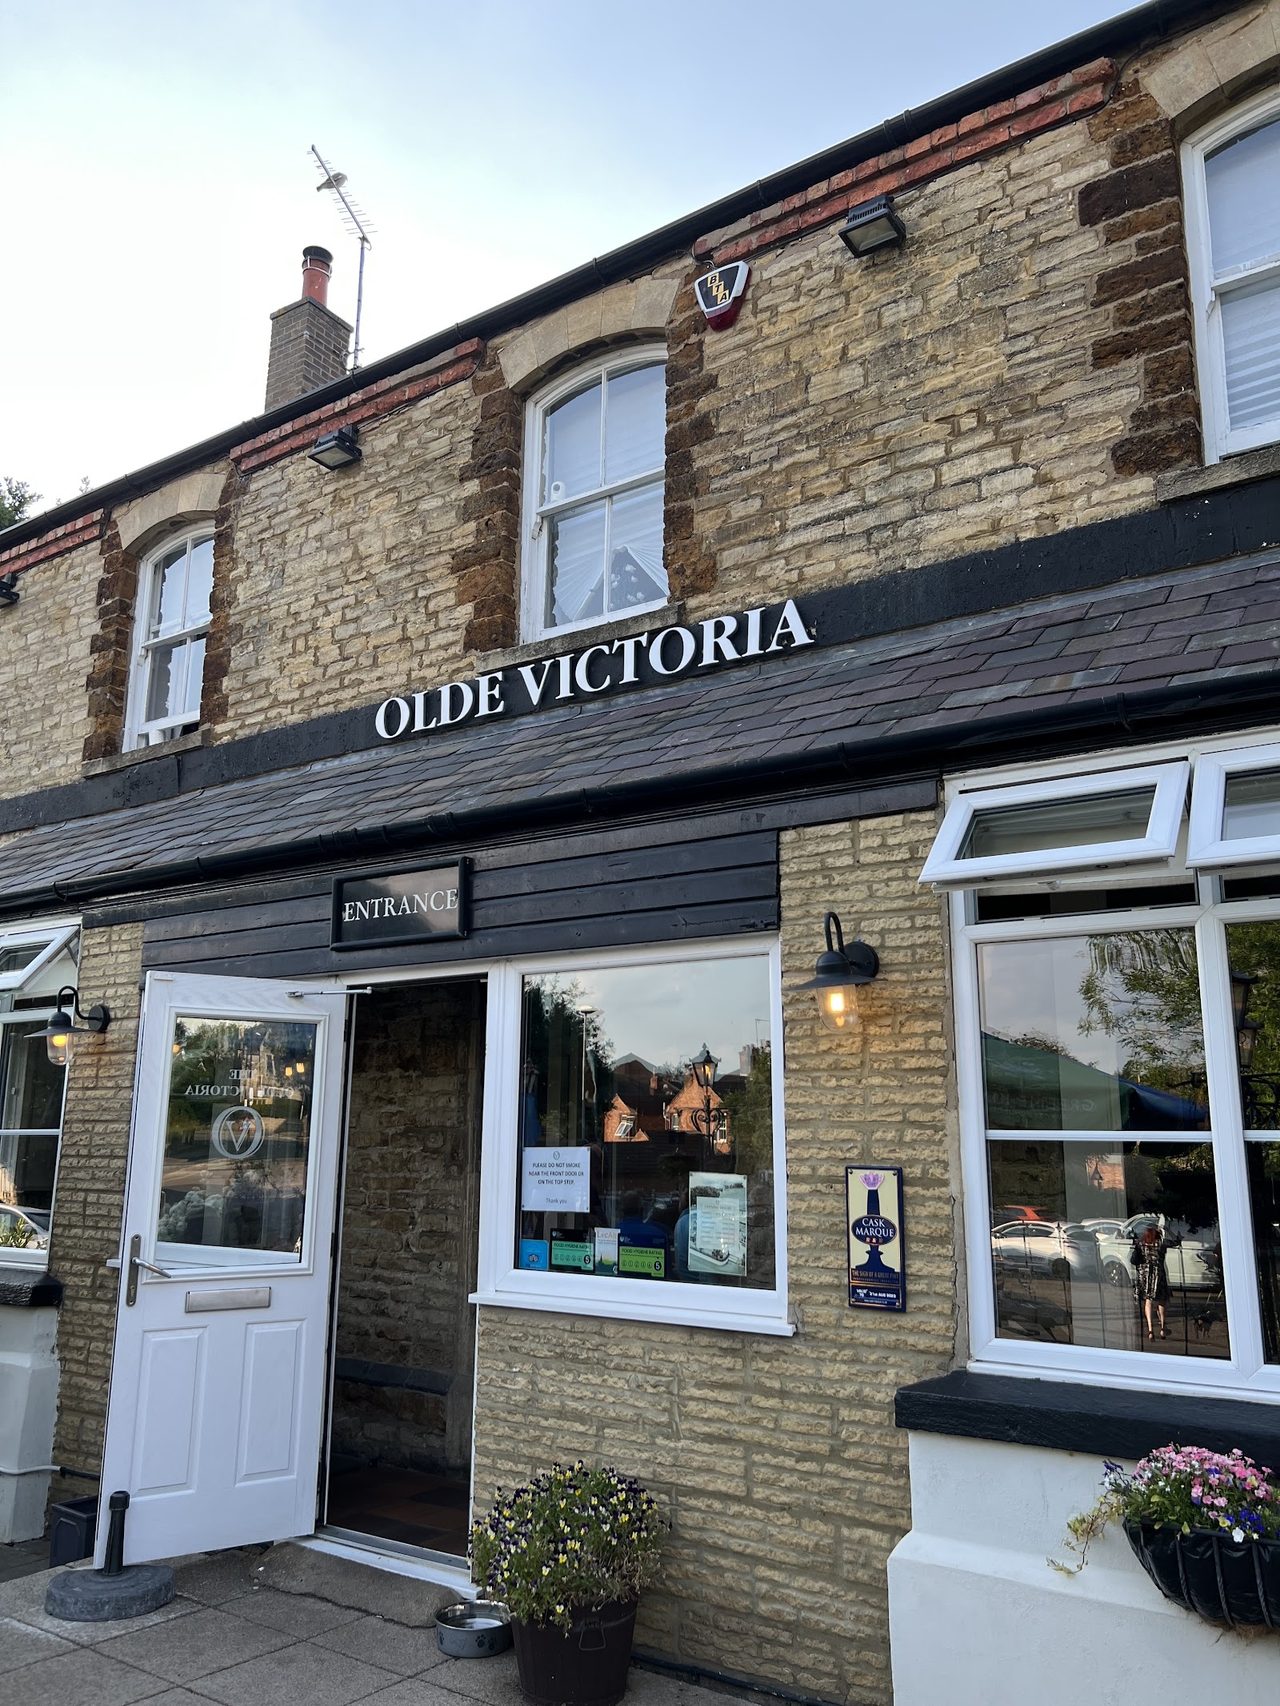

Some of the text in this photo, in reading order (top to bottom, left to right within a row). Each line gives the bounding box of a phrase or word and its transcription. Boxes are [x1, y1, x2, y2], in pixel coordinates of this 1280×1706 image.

[375, 599, 815, 740] OLDE VICTORIA
[343, 889, 459, 922] ENTRANCE
[855, 1227, 894, 1237] MARQUE
[861, 1217, 885, 1227] CASK
